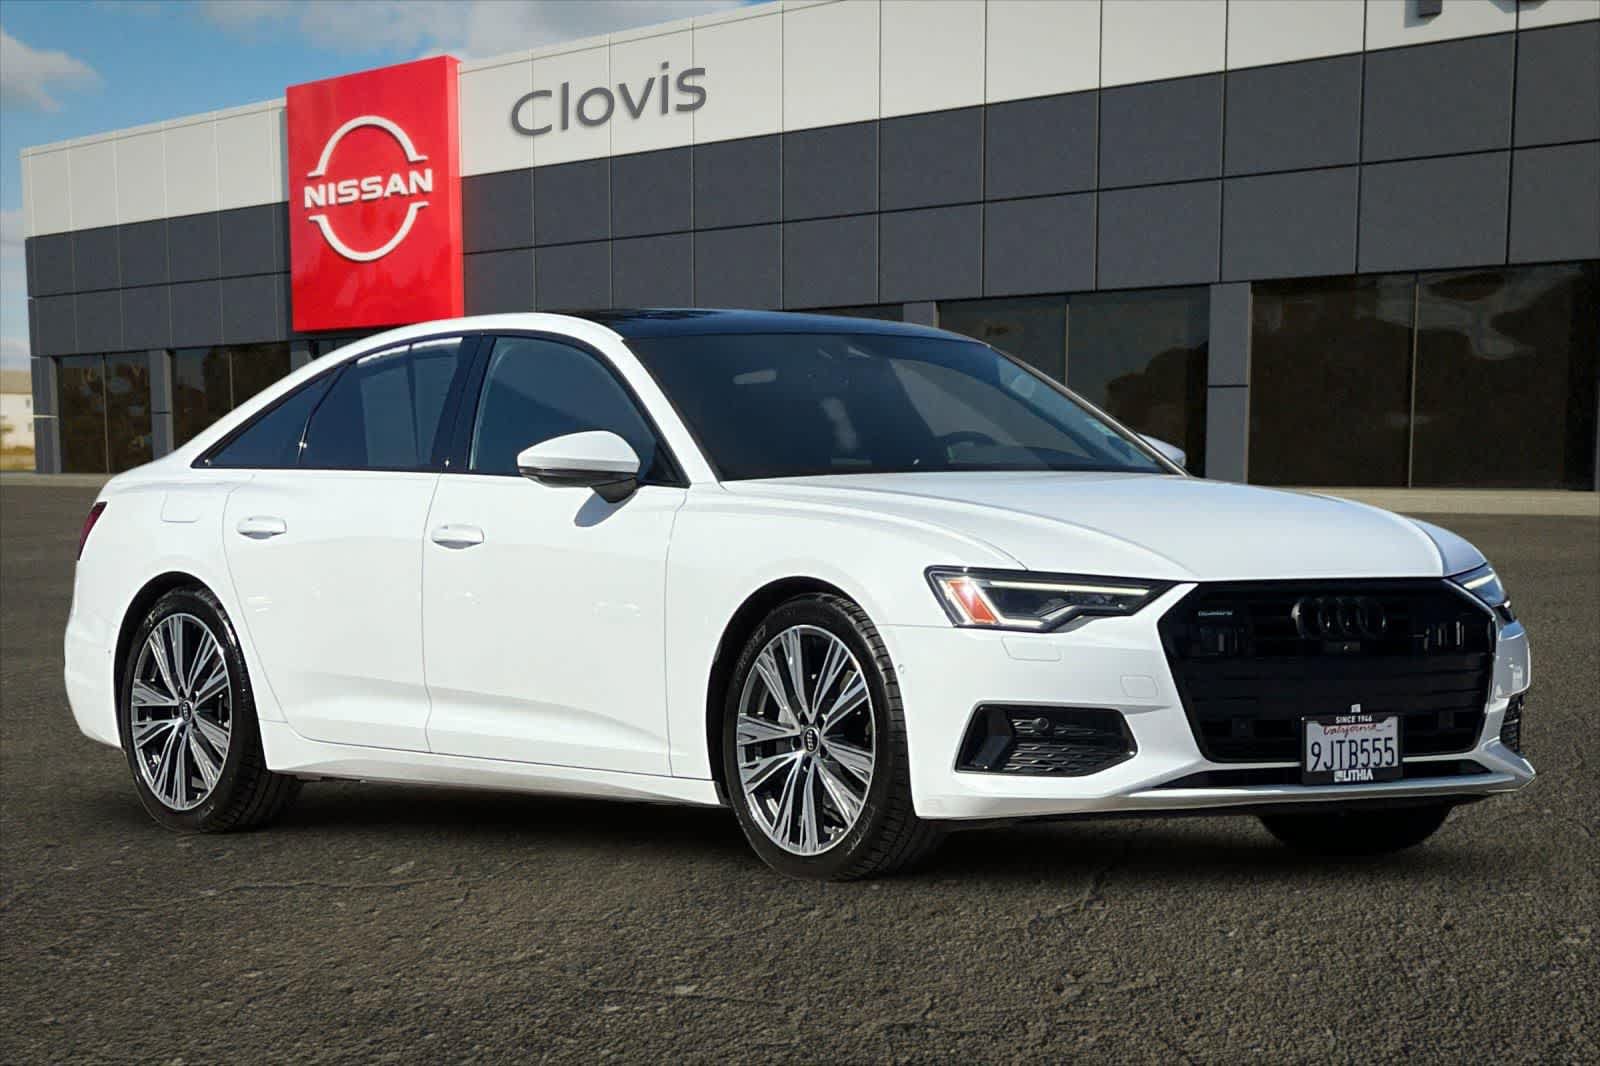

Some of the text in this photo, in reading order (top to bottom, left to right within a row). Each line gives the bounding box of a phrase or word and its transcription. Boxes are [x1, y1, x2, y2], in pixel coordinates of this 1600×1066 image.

[511, 61, 708, 136] Clovis
[303, 168, 433, 210] NISSAN
[1323, 723, 1377, 738] California
[1336, 716, 1356, 724] SINCE
[1311, 737, 1395, 771] 9JTB555
[1343, 769, 1374, 782] LITHIA
